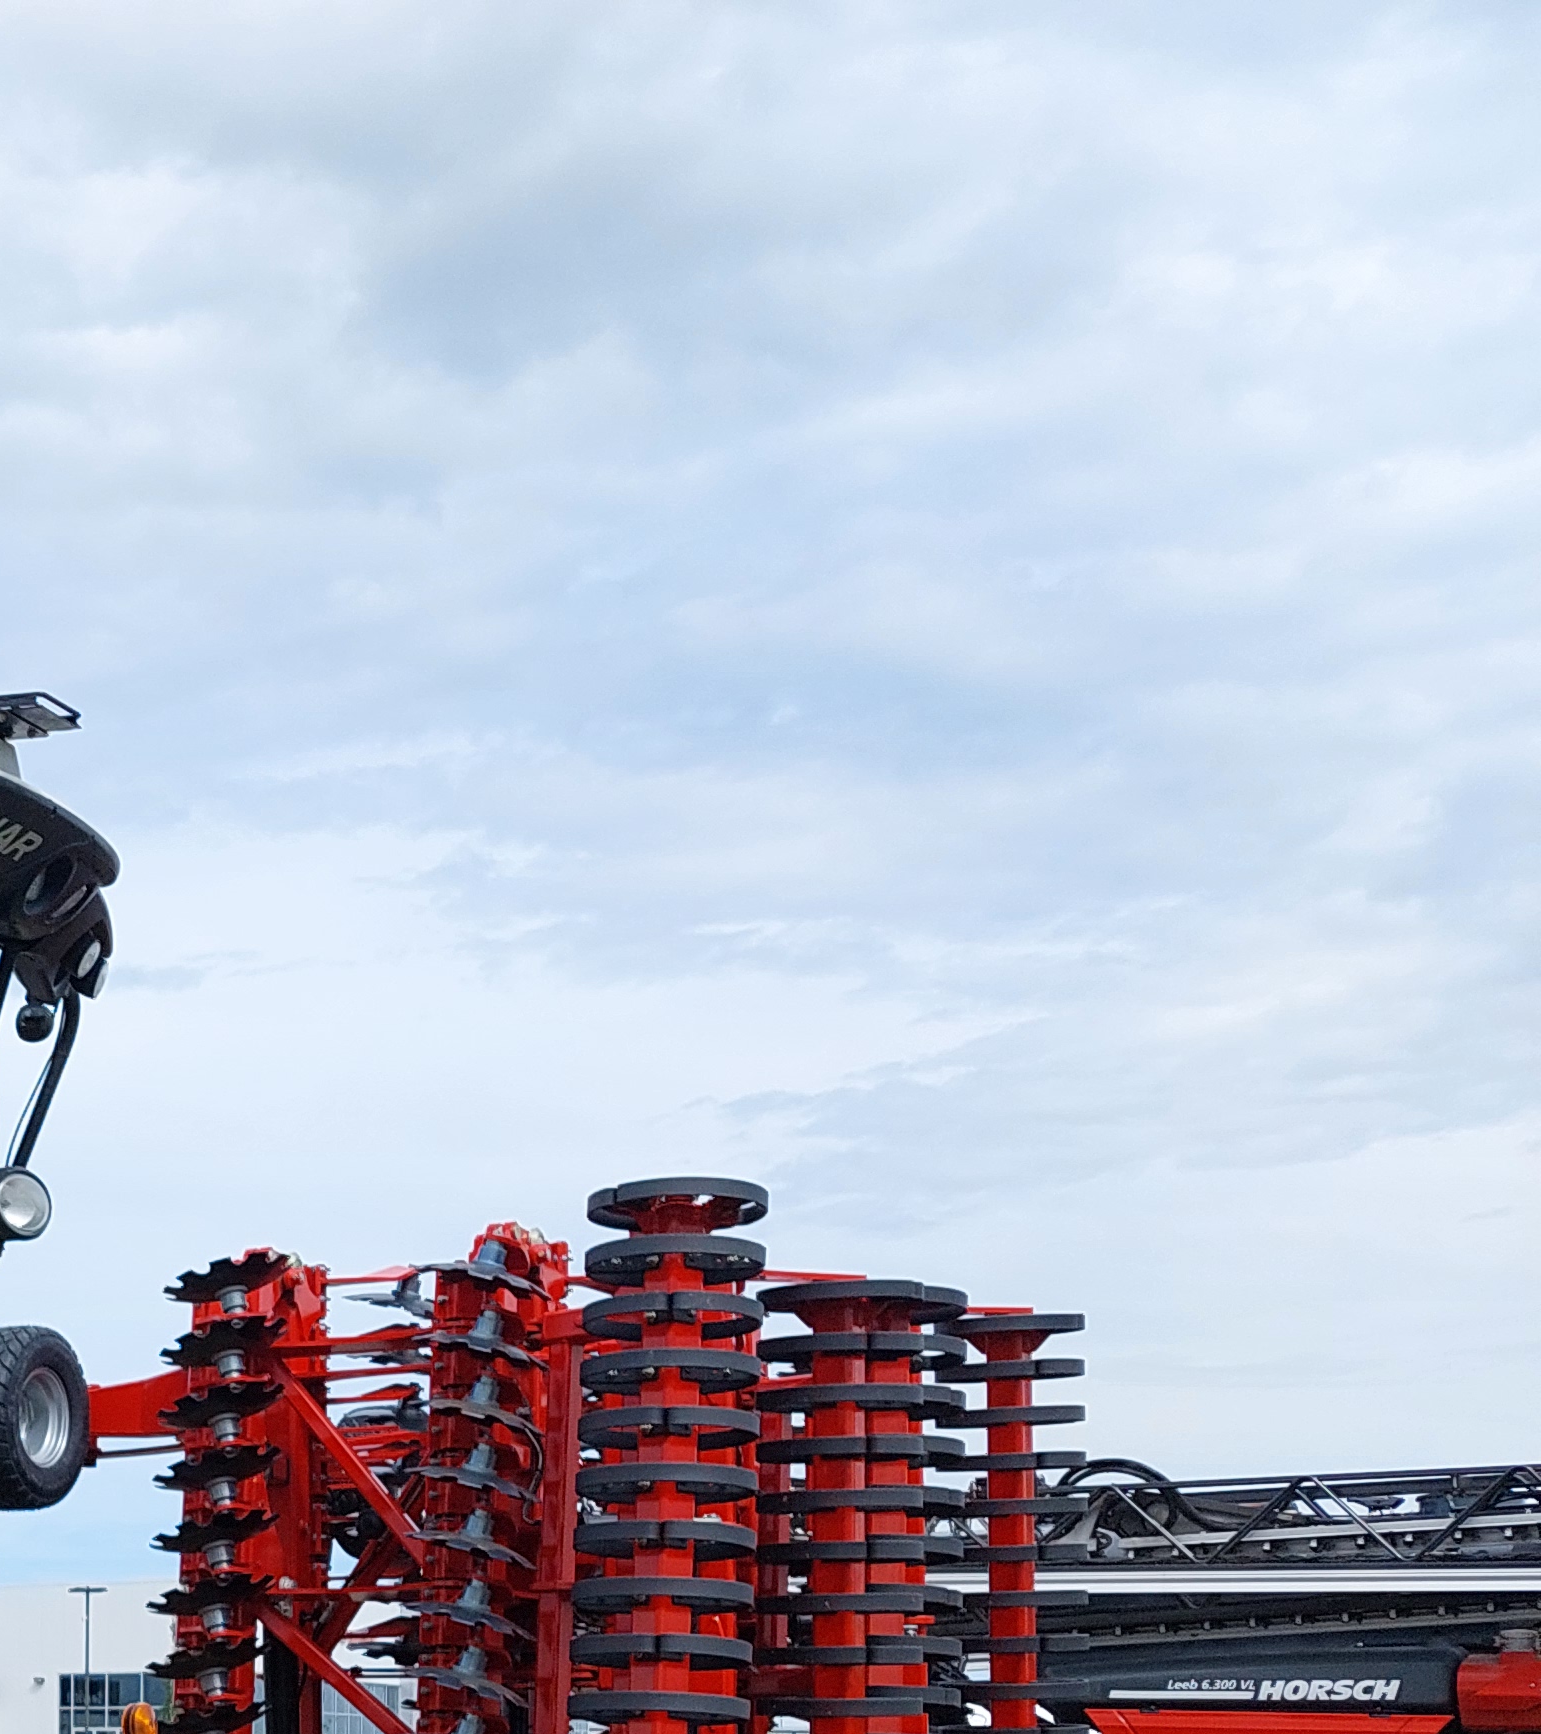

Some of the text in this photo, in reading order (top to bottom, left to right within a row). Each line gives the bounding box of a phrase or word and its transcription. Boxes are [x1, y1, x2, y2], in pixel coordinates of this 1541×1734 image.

[1167, 1679, 1256, 1690] Leeb 6.300 VL
[1258, 1679, 1401, 1700] HORSCH
